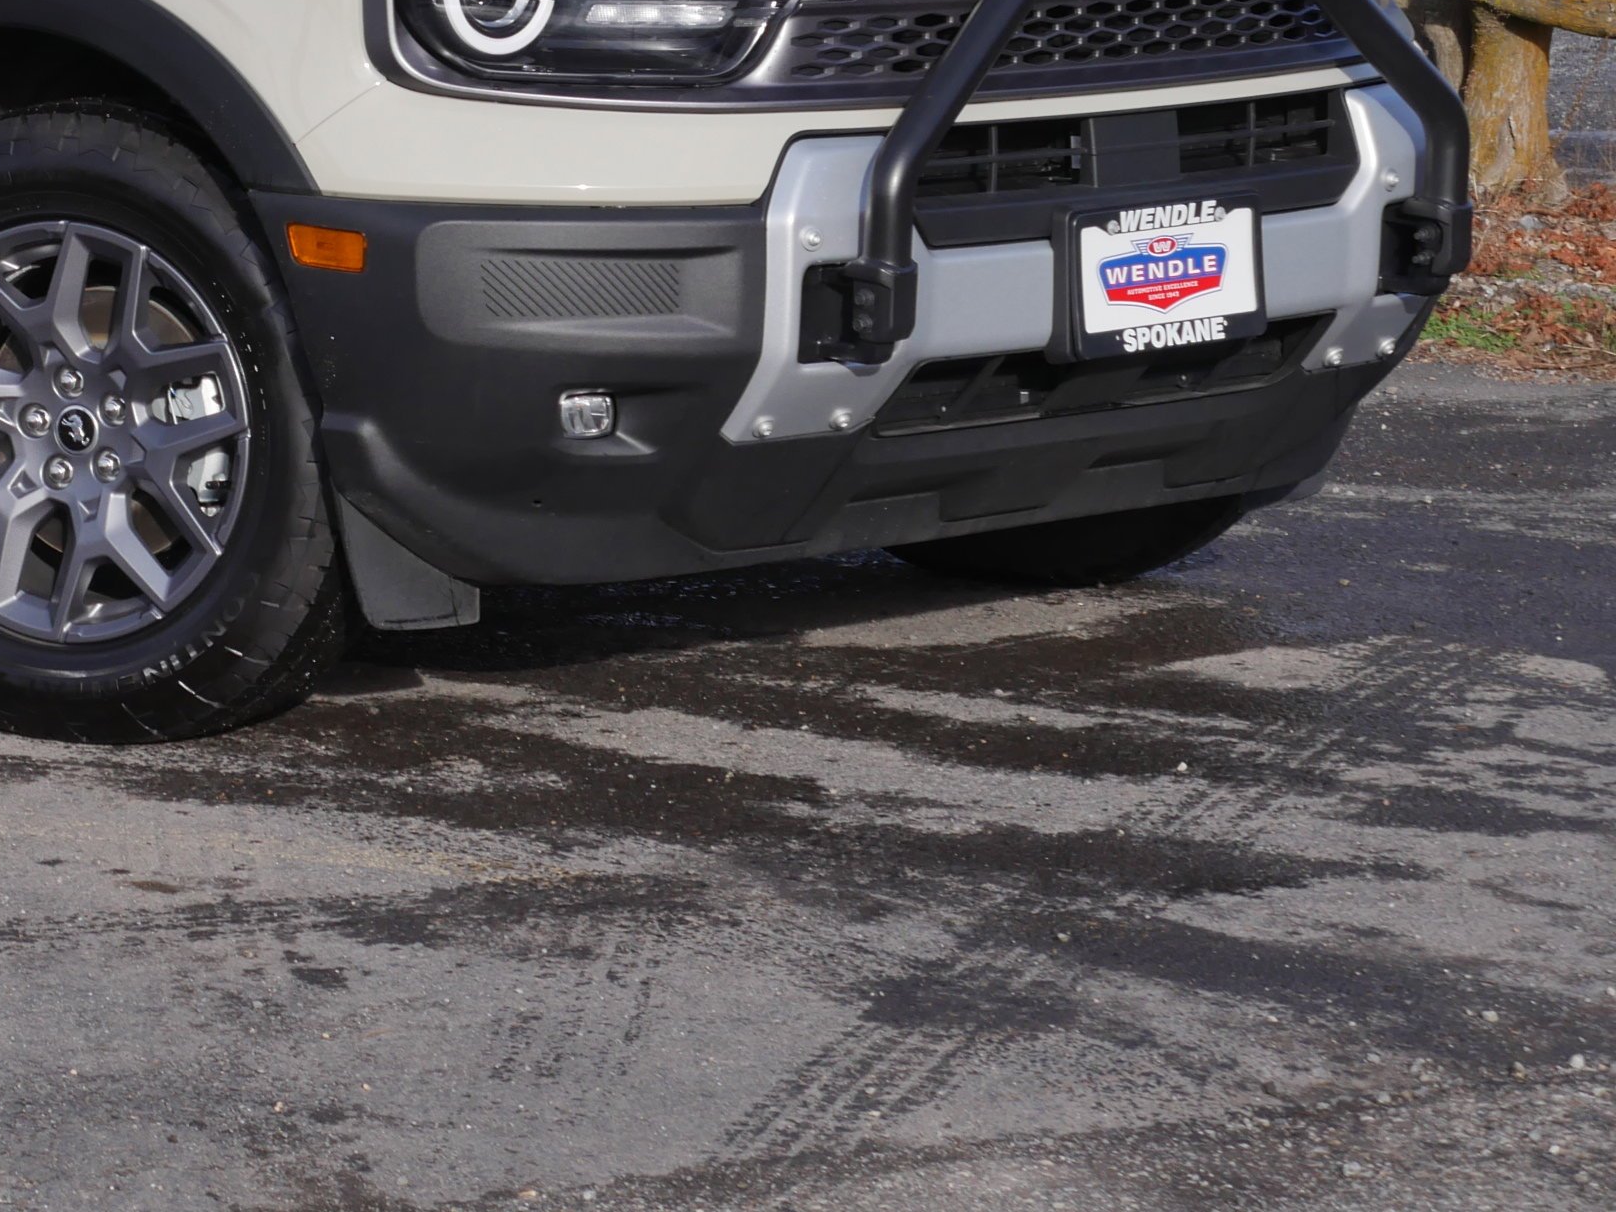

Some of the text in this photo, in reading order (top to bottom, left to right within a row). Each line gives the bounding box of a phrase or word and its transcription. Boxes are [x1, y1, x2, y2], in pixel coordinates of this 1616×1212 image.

[1119, 200, 1217, 233] WENDLE
[1153, 240, 1173, 253] W
[1105, 255, 1218, 285] WENDLE
[1127, 280, 1199, 295] AUTOMOTIVE EXCELLENCE
[1148, 292, 1165, 301] SINCE
[1122, 317, 1226, 353] SPOKANE
